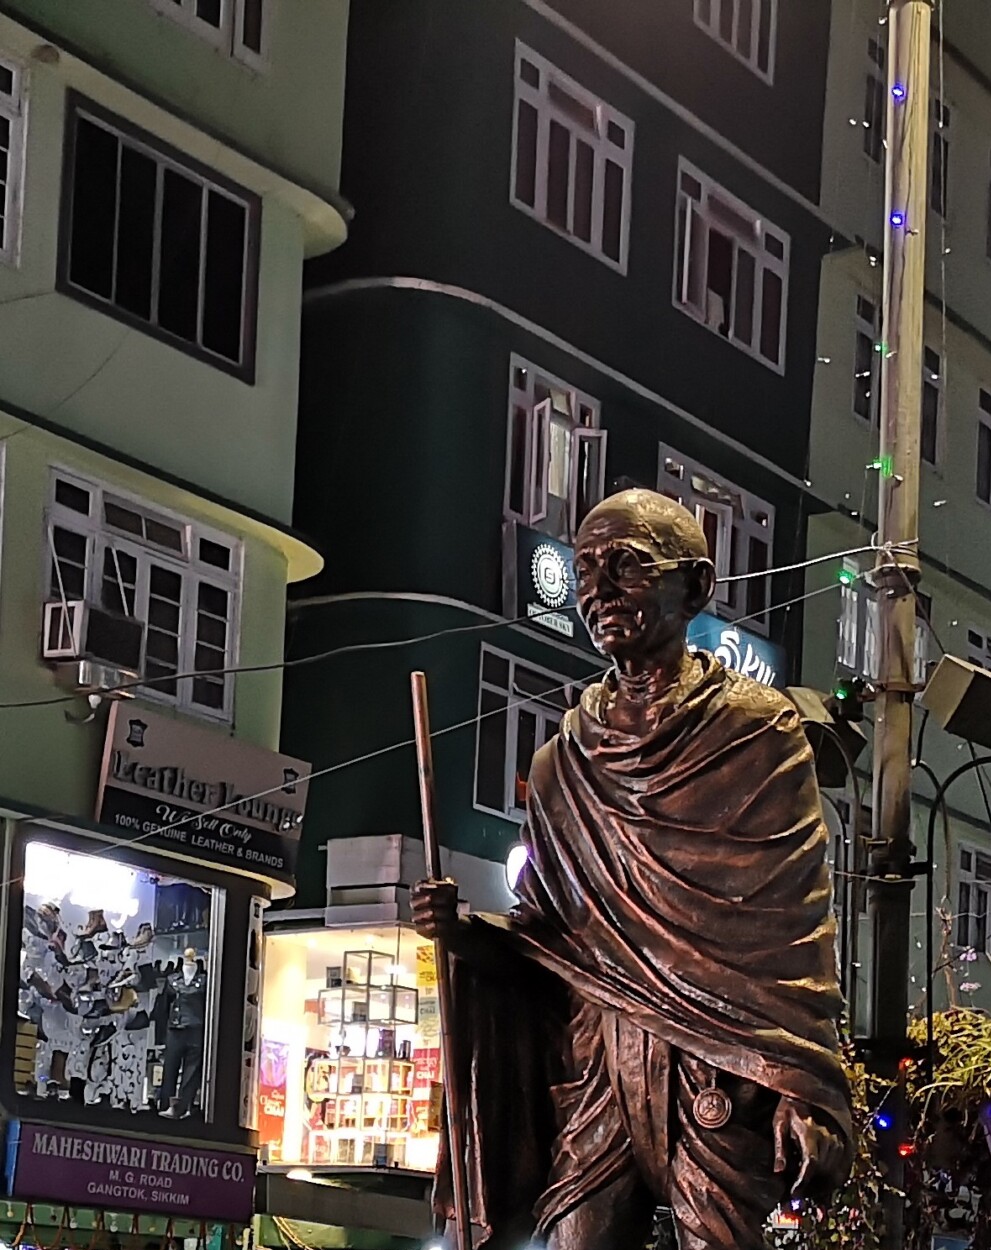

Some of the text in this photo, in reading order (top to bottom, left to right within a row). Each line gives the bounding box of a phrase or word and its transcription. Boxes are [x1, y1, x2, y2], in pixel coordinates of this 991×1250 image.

[115, 813, 284, 868] 100% GENUINE LEATHER & BRANDS
[219, 822, 252, 843] Only
[32, 1132, 245, 1183] MAHESHWARI TRADING CO.
[139, 1174, 172, 1189] ROAD
[87, 1182, 190, 1206] GANGTOK, SIKKIM
